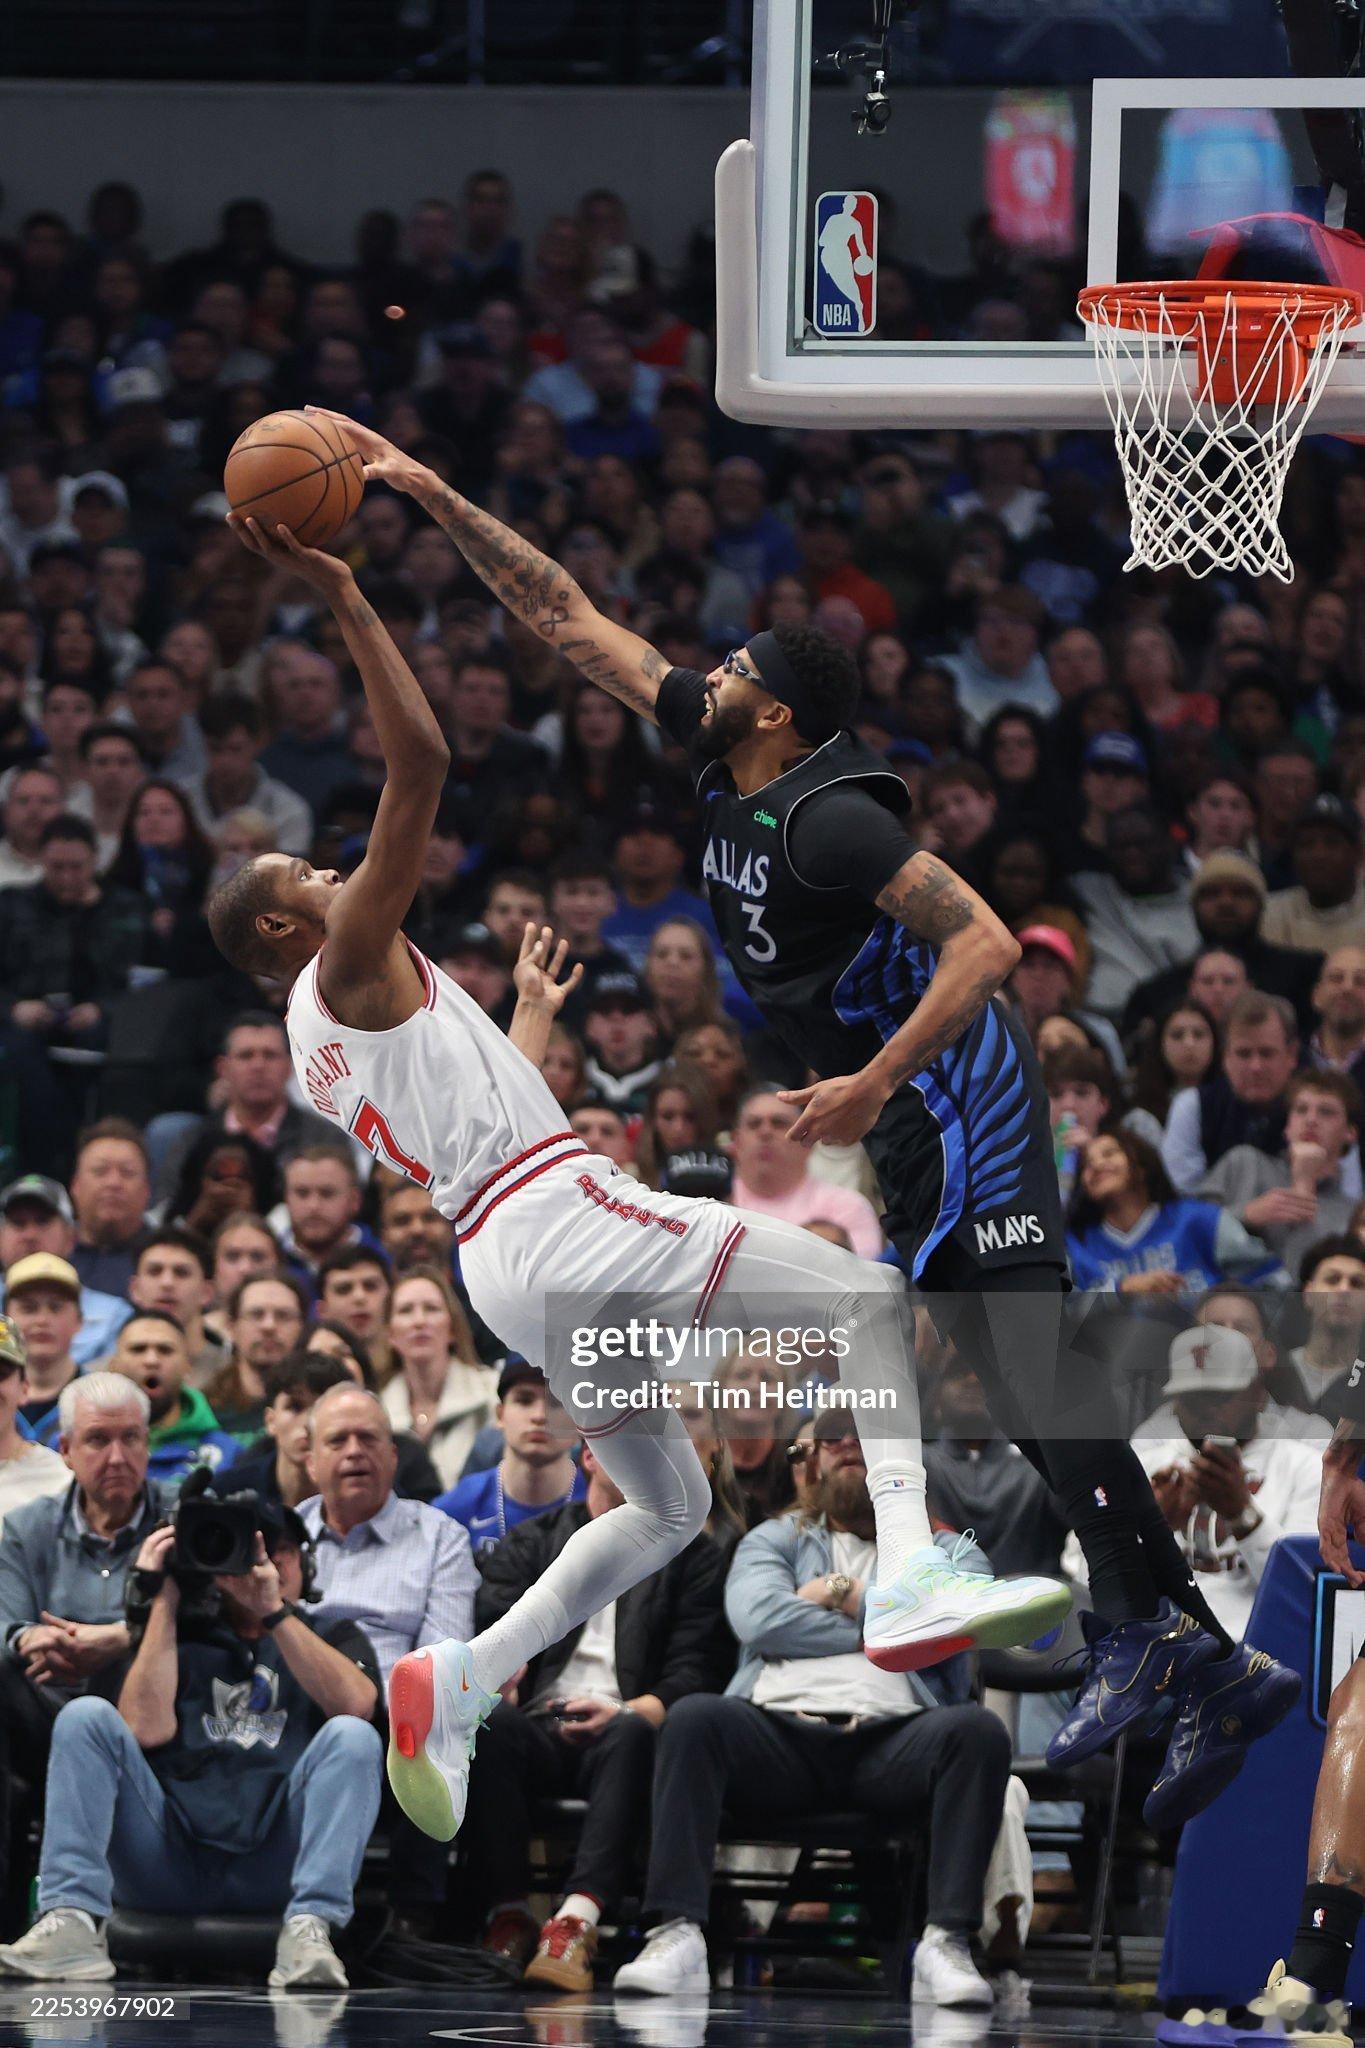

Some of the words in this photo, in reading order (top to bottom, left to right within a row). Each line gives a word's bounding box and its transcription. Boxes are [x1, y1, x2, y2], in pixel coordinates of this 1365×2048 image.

[822, 303, 852, 326] NBA
[753, 808, 778, 829] chime
[702, 834, 770, 898] ALLAS
[741, 901, 777, 963] 3
[305, 1042, 352, 1117] DURANT
[348, 1094, 436, 1192] 7
[972, 1214, 1045, 1254] MAVS
